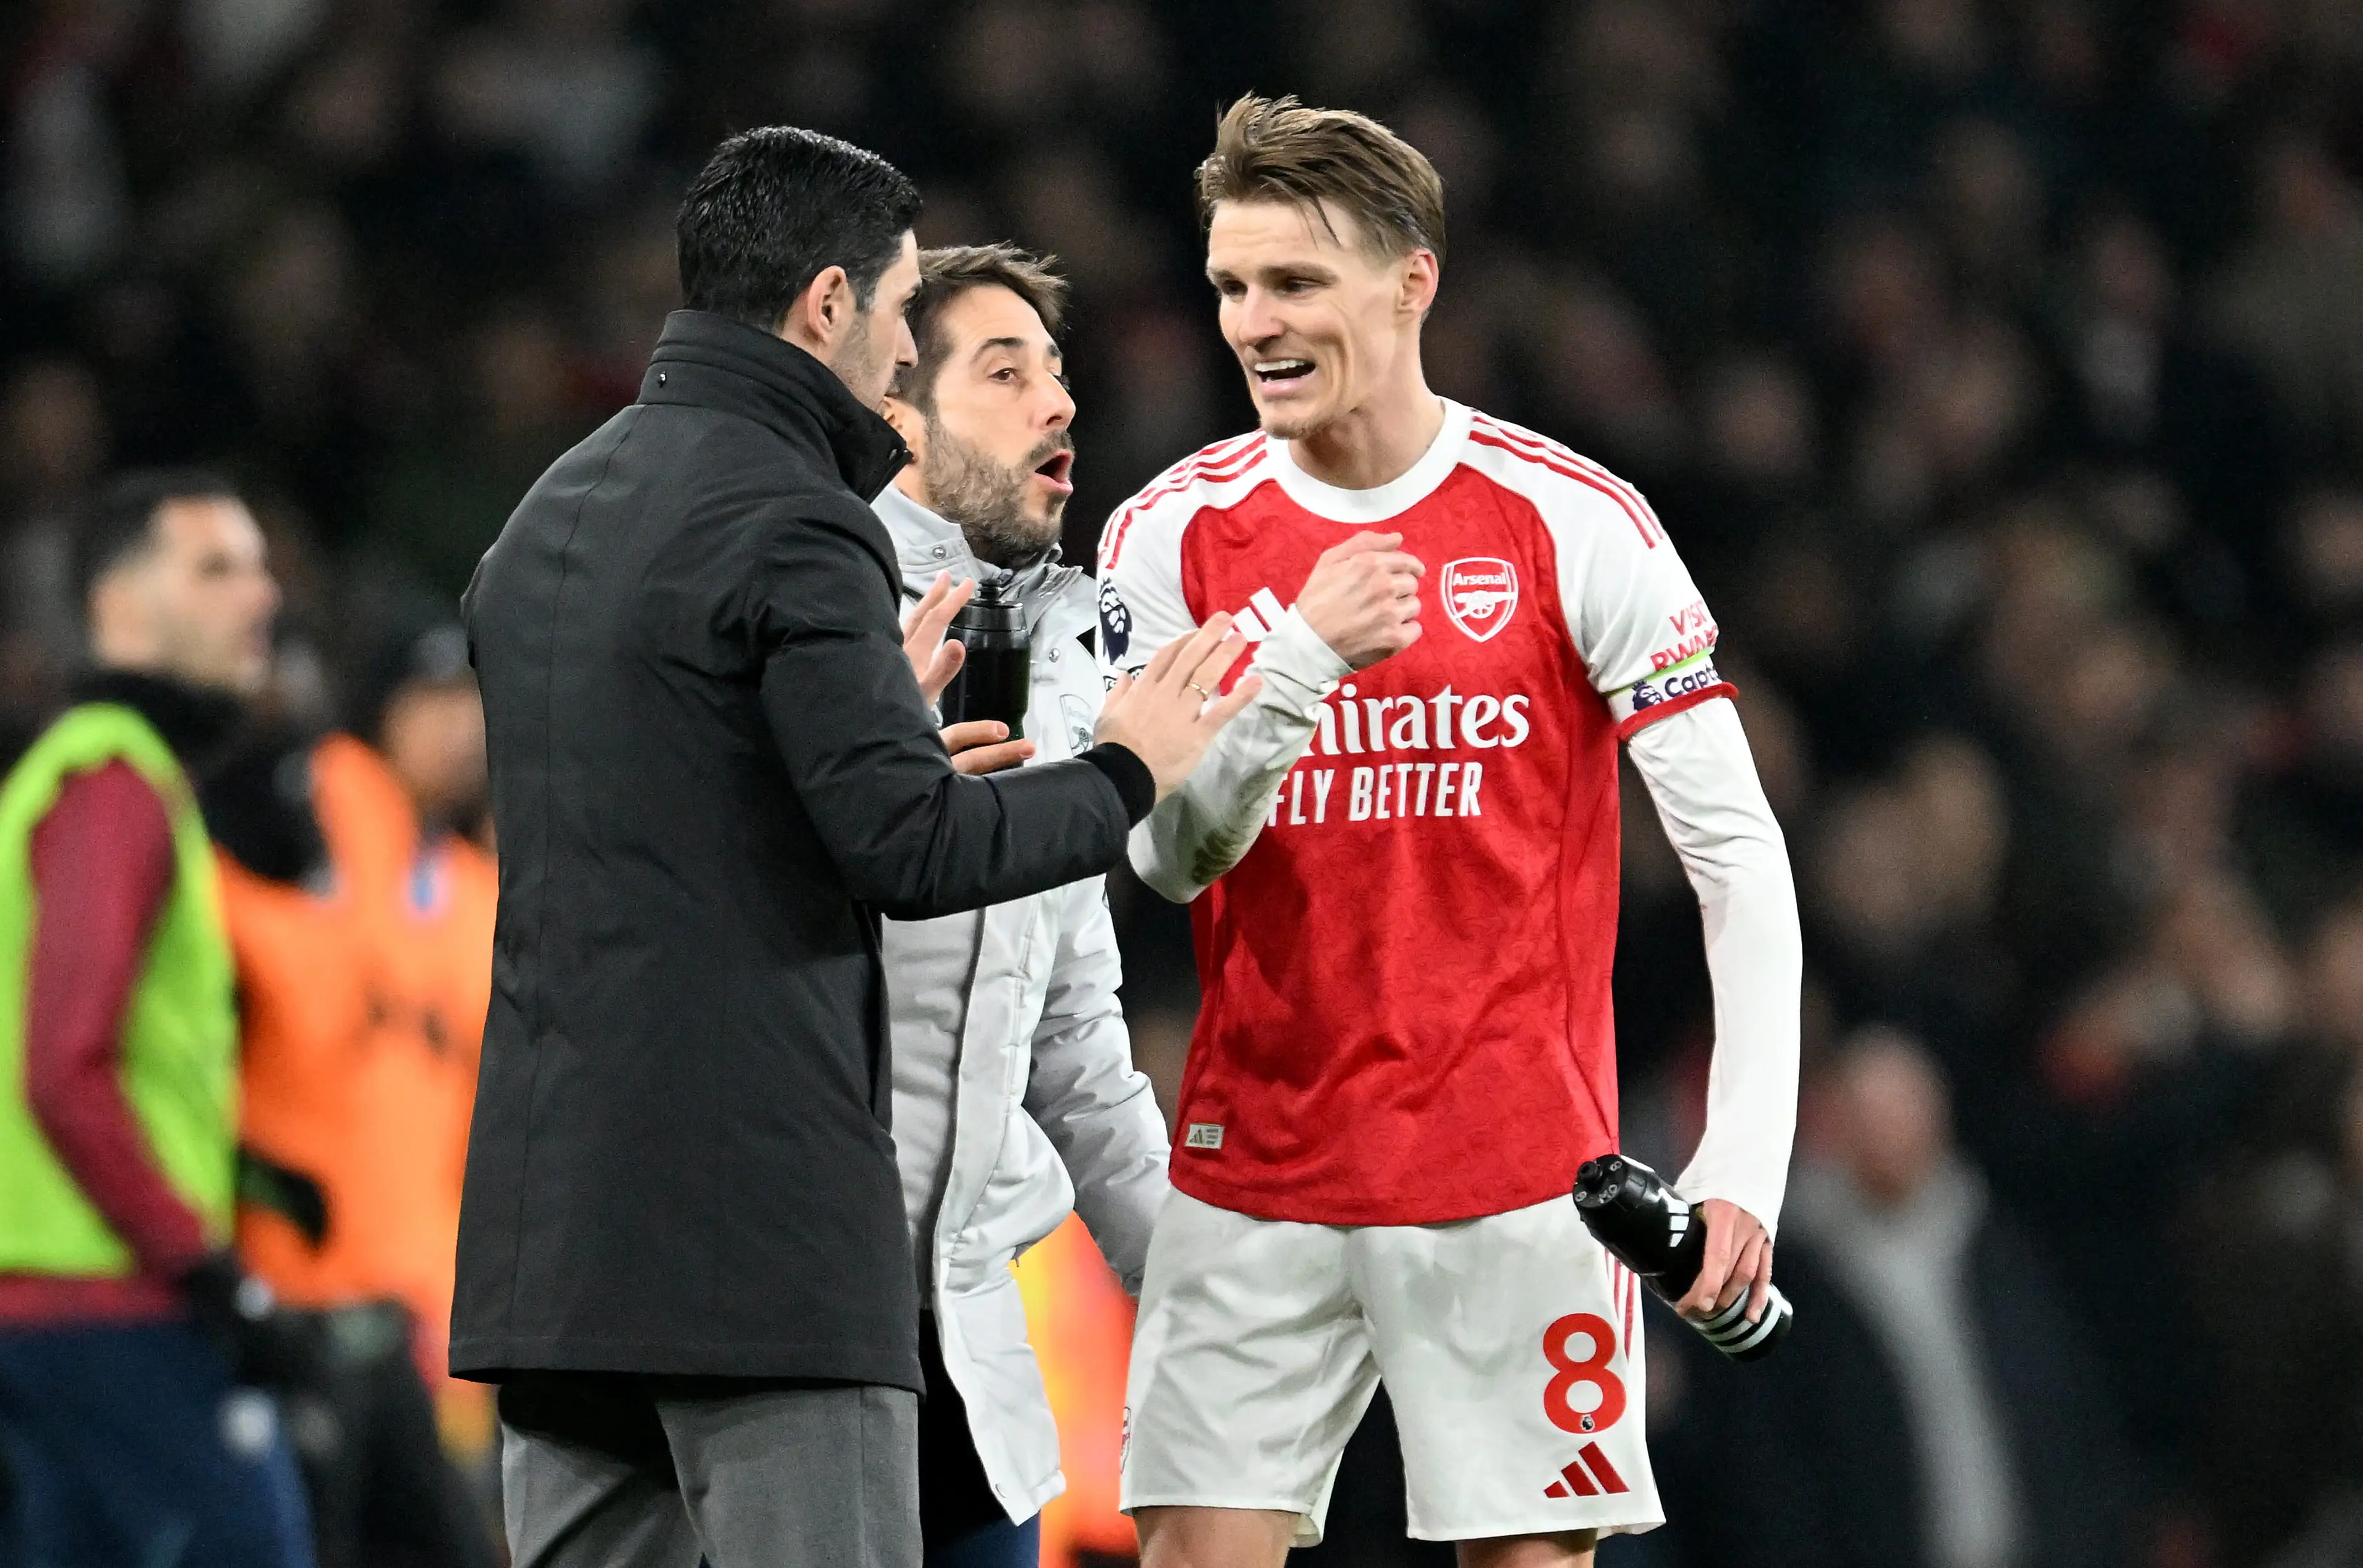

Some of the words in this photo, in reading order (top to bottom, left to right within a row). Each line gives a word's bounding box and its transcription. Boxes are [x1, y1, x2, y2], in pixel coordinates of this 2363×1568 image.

[1453, 573, 1507, 586] Arsenal
[1301, 683, 1530, 757] irates
[1349, 762, 1484, 822] BETTER
[1543, 1313, 1626, 1434] 8
